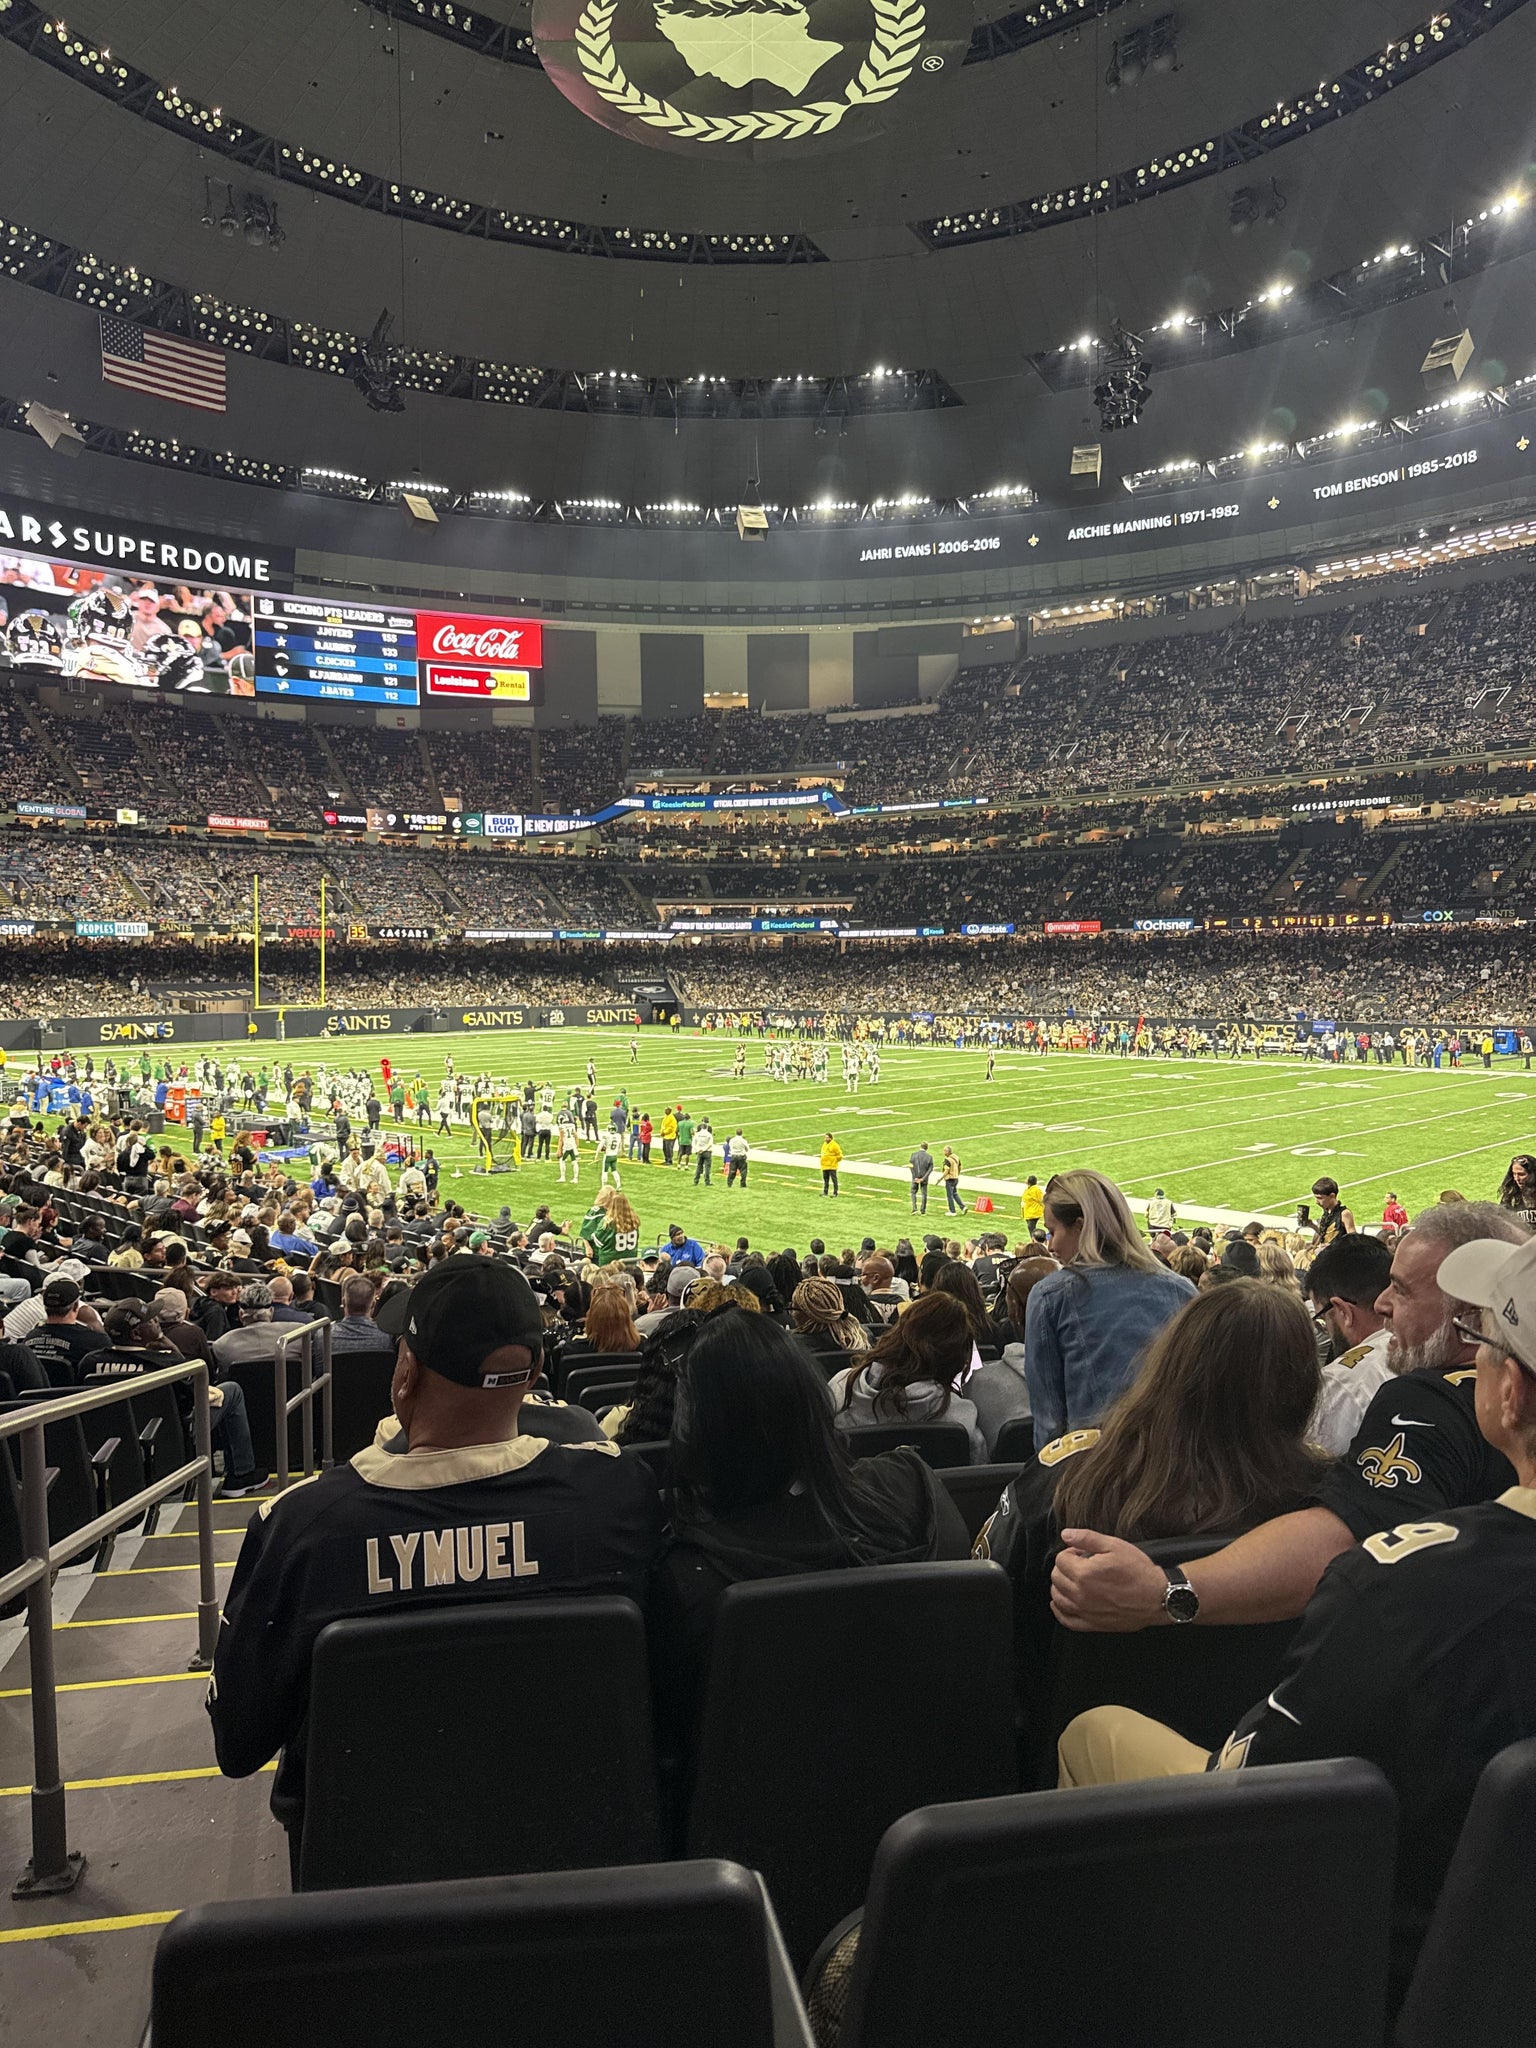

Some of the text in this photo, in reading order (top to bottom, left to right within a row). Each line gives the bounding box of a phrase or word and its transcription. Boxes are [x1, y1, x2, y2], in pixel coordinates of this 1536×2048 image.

[1313, 449, 1478, 500] TOM BENSON 1985-2018
[1067, 504, 1240, 541] ARCHIE MANNING 1971-1982
[73, 527, 270, 582] SUPERDOME
[860, 537, 1000, 562] JAHRI EVANS 2006-2016
[283, 602, 324, 617] KICKING
[324, 607, 343, 618] PTS
[343, 609, 385, 624] LEADERS
[432, 624, 524, 659] Coca-Cola
[434, 674, 479, 688] Louisiana
[500, 680, 525, 689] Rental
[385, 691, 398, 700] 112
[1450, 745, 1485, 756] SAINTS
[1373, 754, 1408, 764] SAINTS
[1302, 762, 1335, 771] SAINTS
[1234, 770, 1265, 779] SAINTS
[1170, 776, 1199, 785] SAINTS
[1108, 782, 1135, 791] SAINTS
[1464, 787, 1498, 797] SAINTS
[1393, 793, 1424, 802] SAINTS
[1291, 796, 1391, 812] CAESARS SUPERDOME
[18, 805, 55, 815] VENTURE
[55, 807, 85, 817] GLOBAL
[1262, 805, 1291, 814] SAINTS
[168, 814, 198, 822] SAINTS
[209, 817, 268, 829] ROUSES MARKETS
[337, 815, 367, 824] TOYOTA
[386, 813, 396, 826] 9
[452, 816, 462, 828] 6
[492, 817, 515, 826] BUD
[295, 822, 323, 830] SAINTS
[488, 825, 520, 834] LIGHT
[535, 820, 553, 832] NEW
[1423, 910, 1453, 921] COX
[1480, 909, 1515, 917] SAINTS
[1143, 919, 1191, 930] Ochsner
[1242, 919, 1249, 927] 9
[1254, 920, 1261, 929] 2
[1272, 919, 1279, 927] 4
[1310, 918, 1322, 926] 41
[1328, 918, 1335, 926] 3
[78, 924, 146, 934] PEOPLES HEALTH
[159, 923, 192, 932] SAINTS
[351, 926, 366, 937] 35
[434, 928, 462, 936] SAINTS
[379, 928, 429, 938] CAESARS
[166, 989, 253, 998] SAINTS
[468, 1010, 523, 1026] SAINTS
[587, 1007, 638, 1023] SAINTS
[328, 1014, 391, 1031] SAINTS
[615, 1229, 638, 1251] 89
[366, 1521, 539, 1594] LYMUEL
